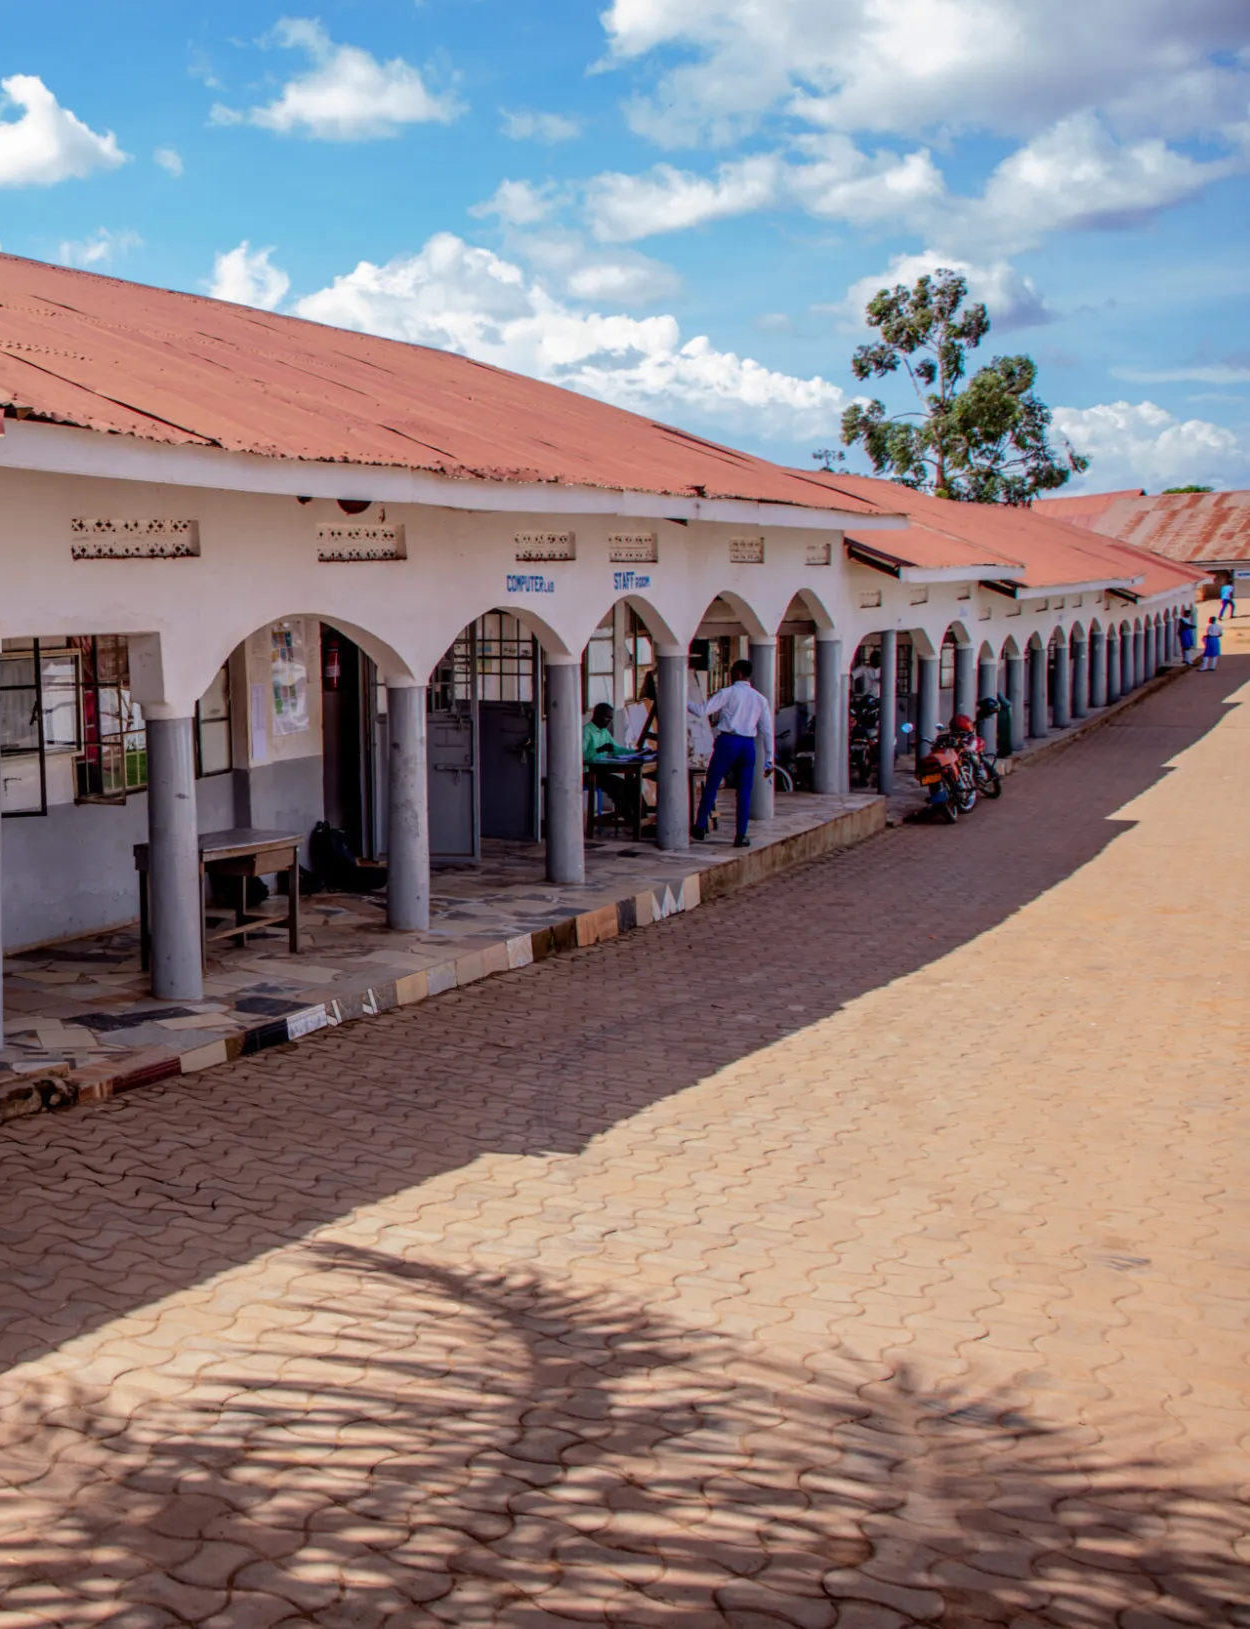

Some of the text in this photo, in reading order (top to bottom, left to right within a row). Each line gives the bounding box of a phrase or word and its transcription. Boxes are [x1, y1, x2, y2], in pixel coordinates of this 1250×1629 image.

[506, 574, 555, 593] COMPUTER LAB
[613, 571, 651, 591] STAFF ROOM
